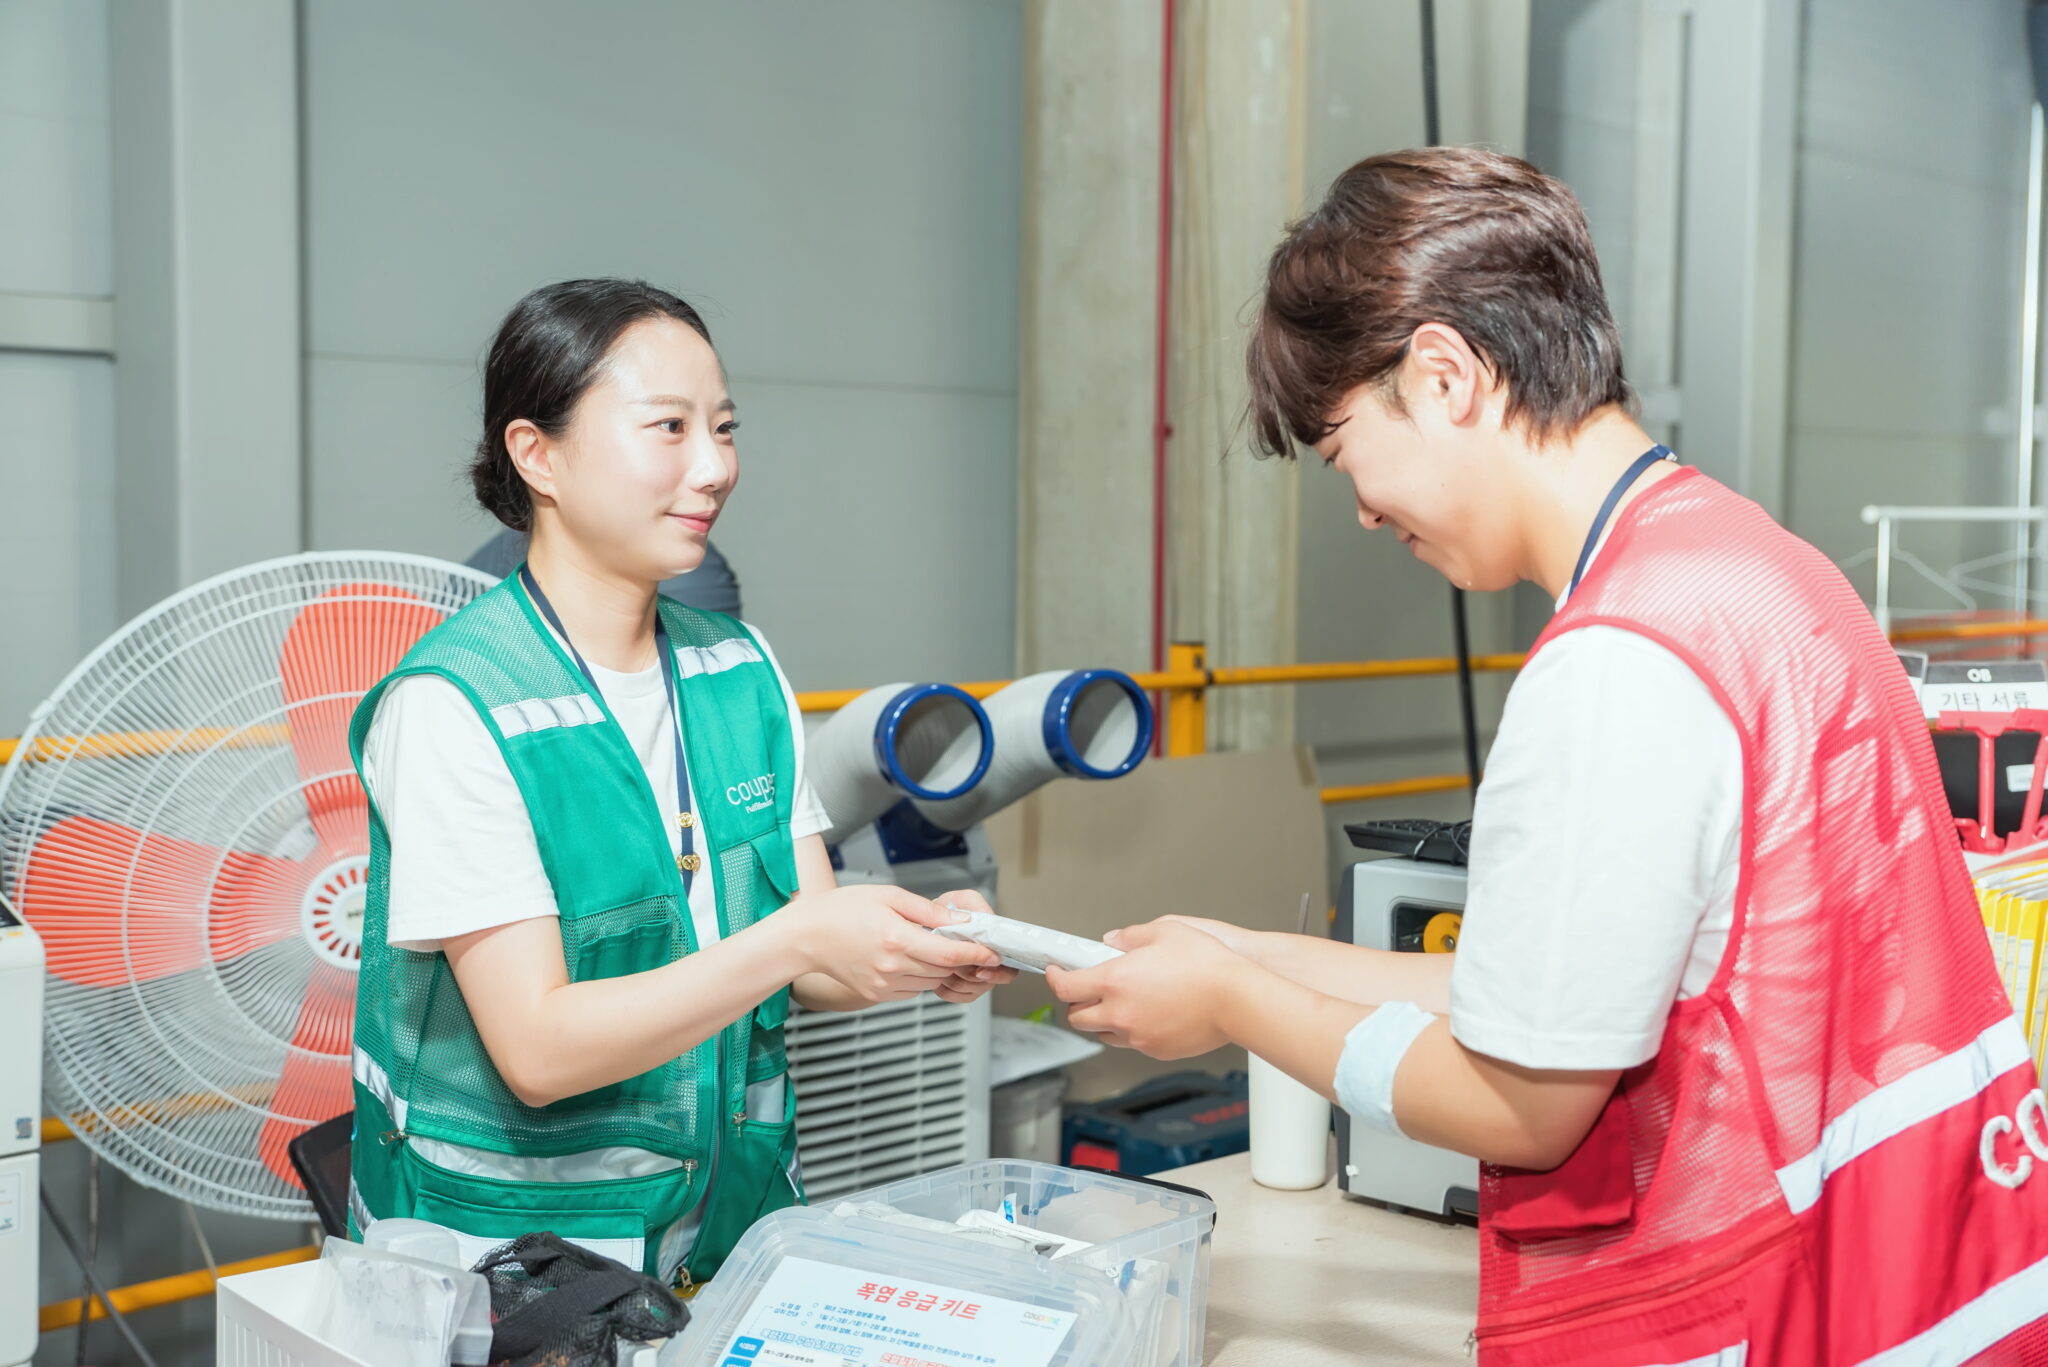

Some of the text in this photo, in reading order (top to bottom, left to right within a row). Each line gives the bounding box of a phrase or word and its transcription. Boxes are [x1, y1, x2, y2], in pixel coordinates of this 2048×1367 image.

[1941, 691, 2029, 711] 기타 서류
[856, 1282, 982, 1320] 폭염 응급 키트
